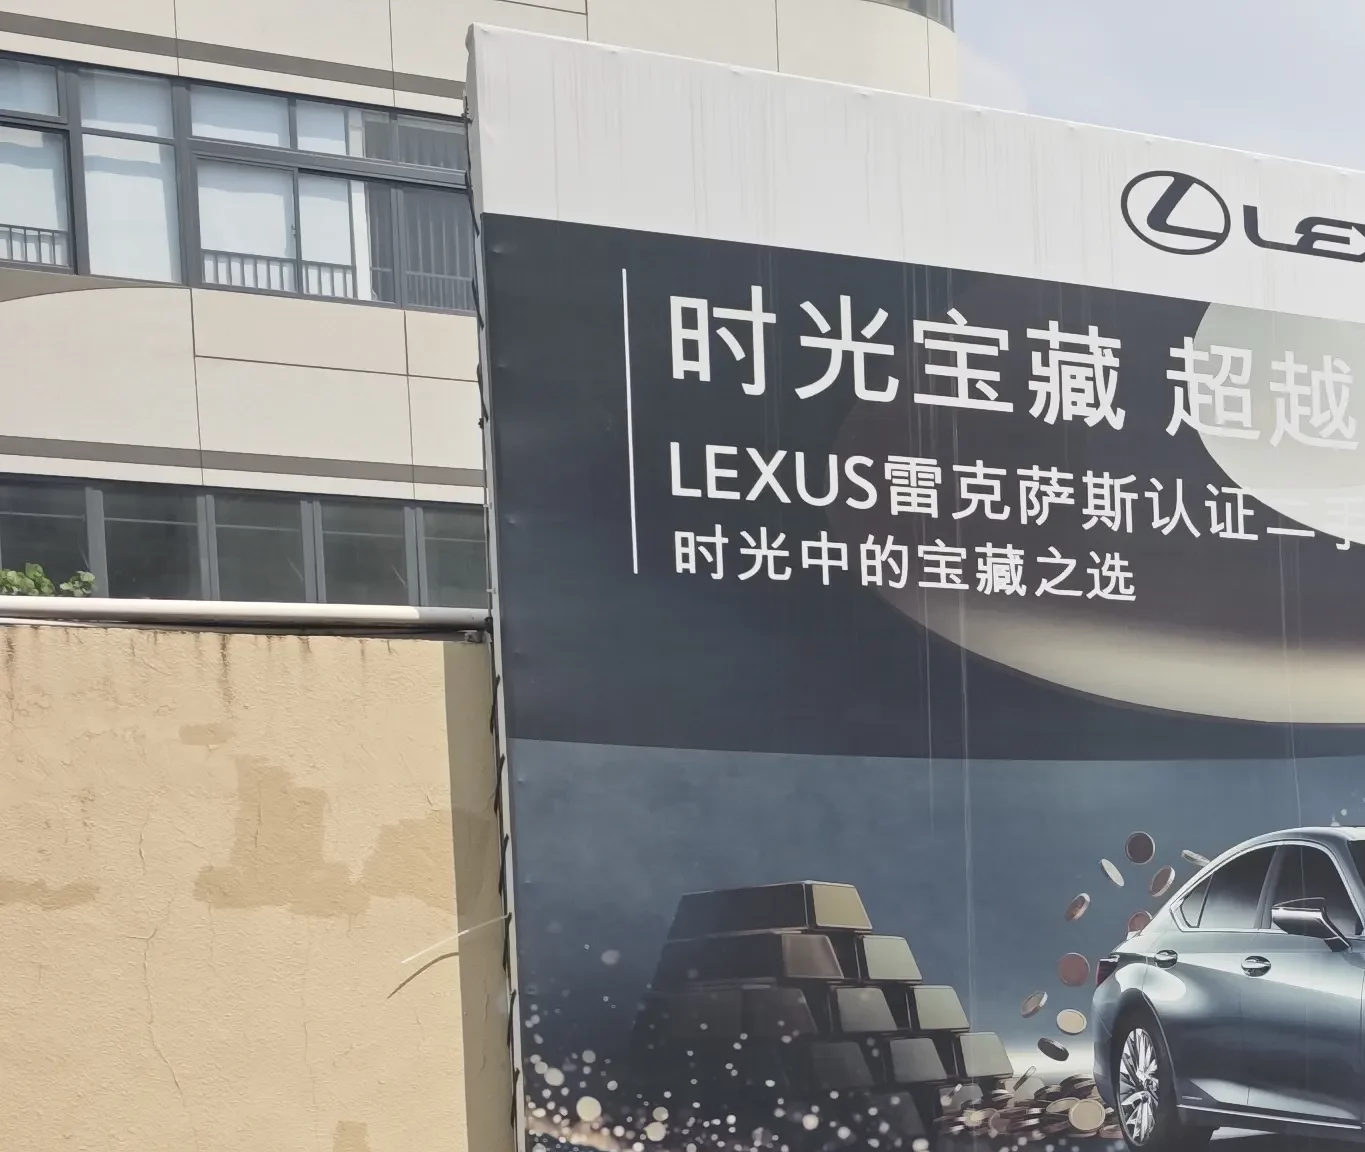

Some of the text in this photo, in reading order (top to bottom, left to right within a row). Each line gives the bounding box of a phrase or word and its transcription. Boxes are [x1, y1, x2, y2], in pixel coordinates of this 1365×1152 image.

[668, 284, 1126, 431] 时光宝藏
[673, 523, 1138, 603] 时光中的宝藏之选
